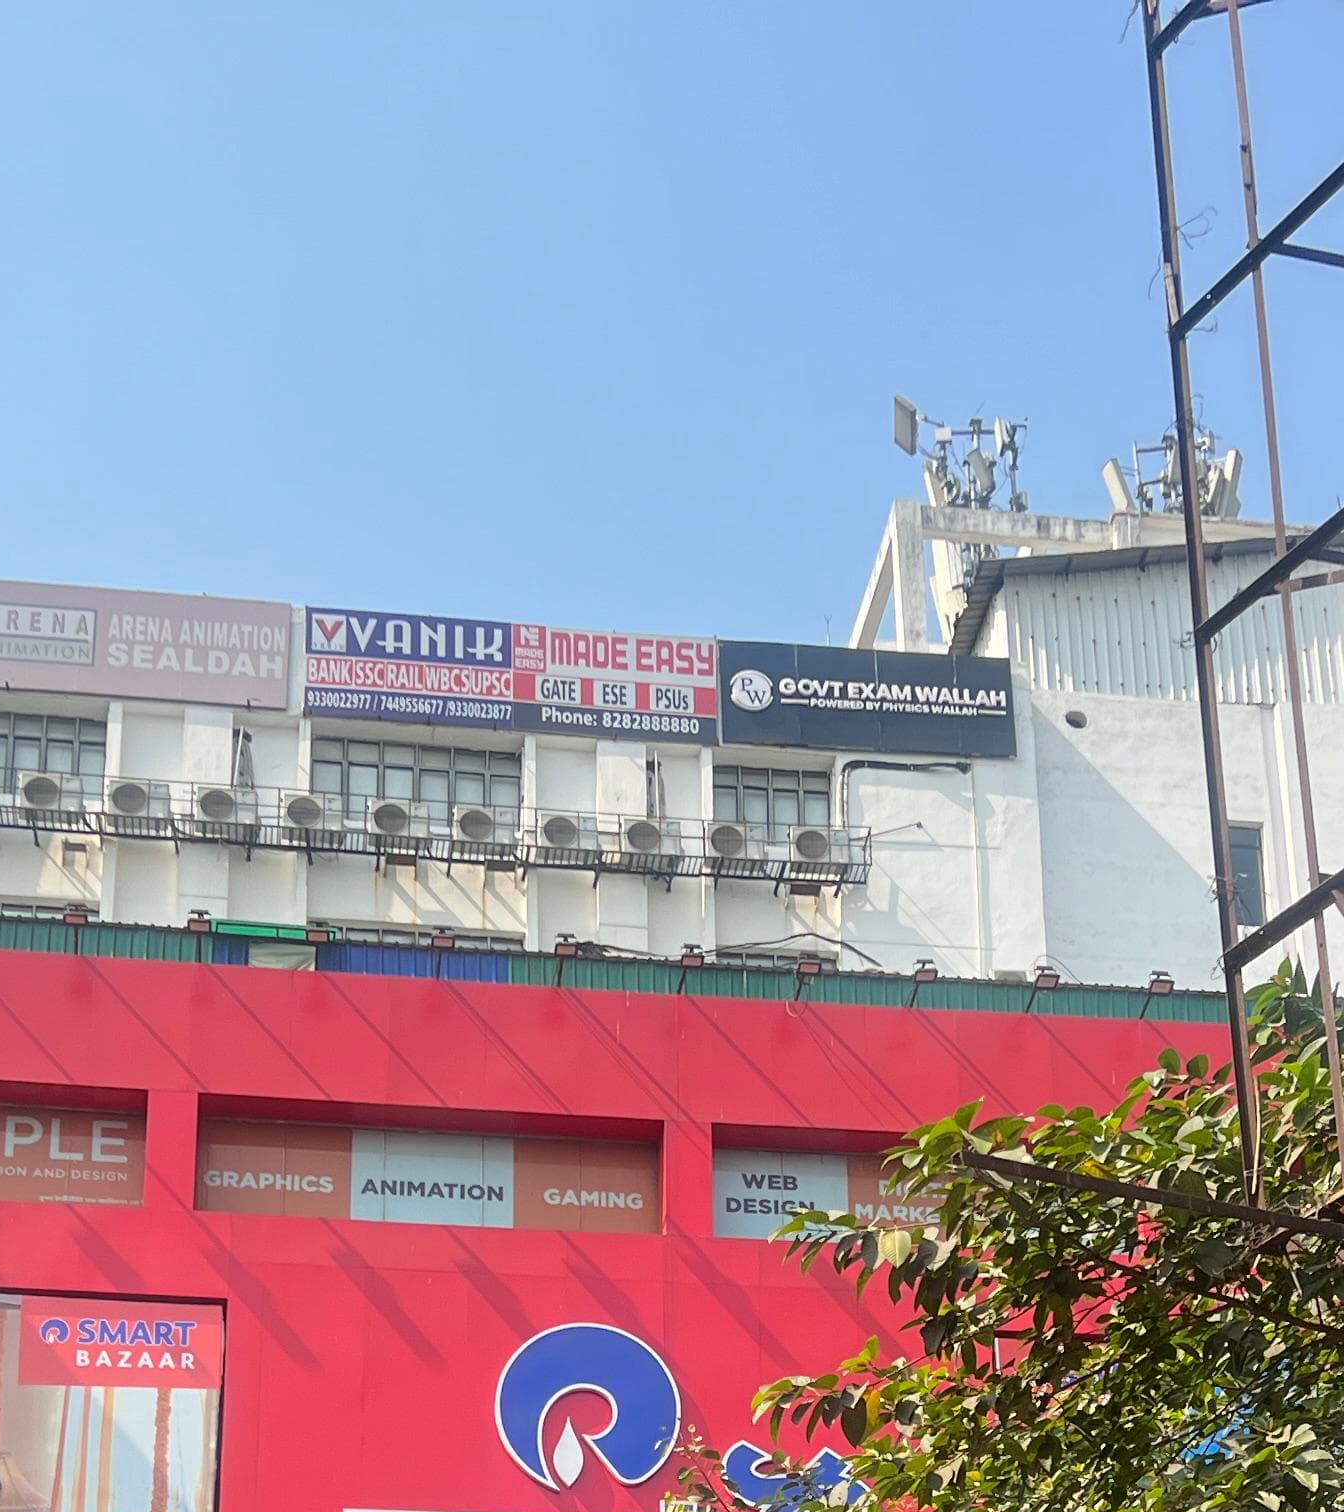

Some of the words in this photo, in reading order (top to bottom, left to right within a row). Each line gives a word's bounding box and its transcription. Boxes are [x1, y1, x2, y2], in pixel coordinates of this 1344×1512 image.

[107, 613, 173, 644] ARENA
[178, 618, 287, 651] ANIMATION
[348, 616, 504, 662] VANIK
[106, 642, 285, 680] SEALDAH
[549, 631, 629, 671] MADE
[635, 639, 715, 677] EASY
[307, 657, 352, 685] BANK
[355, 660, 385, 687] SSC
[386, 663, 424, 690] RAIL
[424, 666, 470, 694] WBCS
[471, 670, 512, 697] UPSC
[778, 677, 843, 698] GOVT
[847, 682, 911, 701] EXAM
[914, 685, 1007, 706] WALLAH
[307, 691, 372, 709] 9330022977
[380, 695, 443, 715] 7449556677
[539, 678, 578, 702] GATE
[600, 682, 628, 707] ESE
[654, 688, 689, 712] PSUs
[809, 697, 864, 710] POWERED
[865, 700, 881, 711] BY
[882, 702, 929, 714] PHYSICS
[930, 704, 978, 717] WALLAH
[541, 705, 598, 728] Phone:
[601, 710, 700, 735] 8282888880
[32, 1166, 66, 1180] AND
[70, 1168, 128, 1183] DESIGN
[741, 1172, 799, 1192] WEB
[203, 1169, 335, 1194] GRAPHICS
[360, 1178, 505, 1203] ANIMATION
[542, 1187, 645, 1211] GAMING
[77, 1317, 198, 1347] SMART
[75, 1349, 196, 1370] BAZAAR
